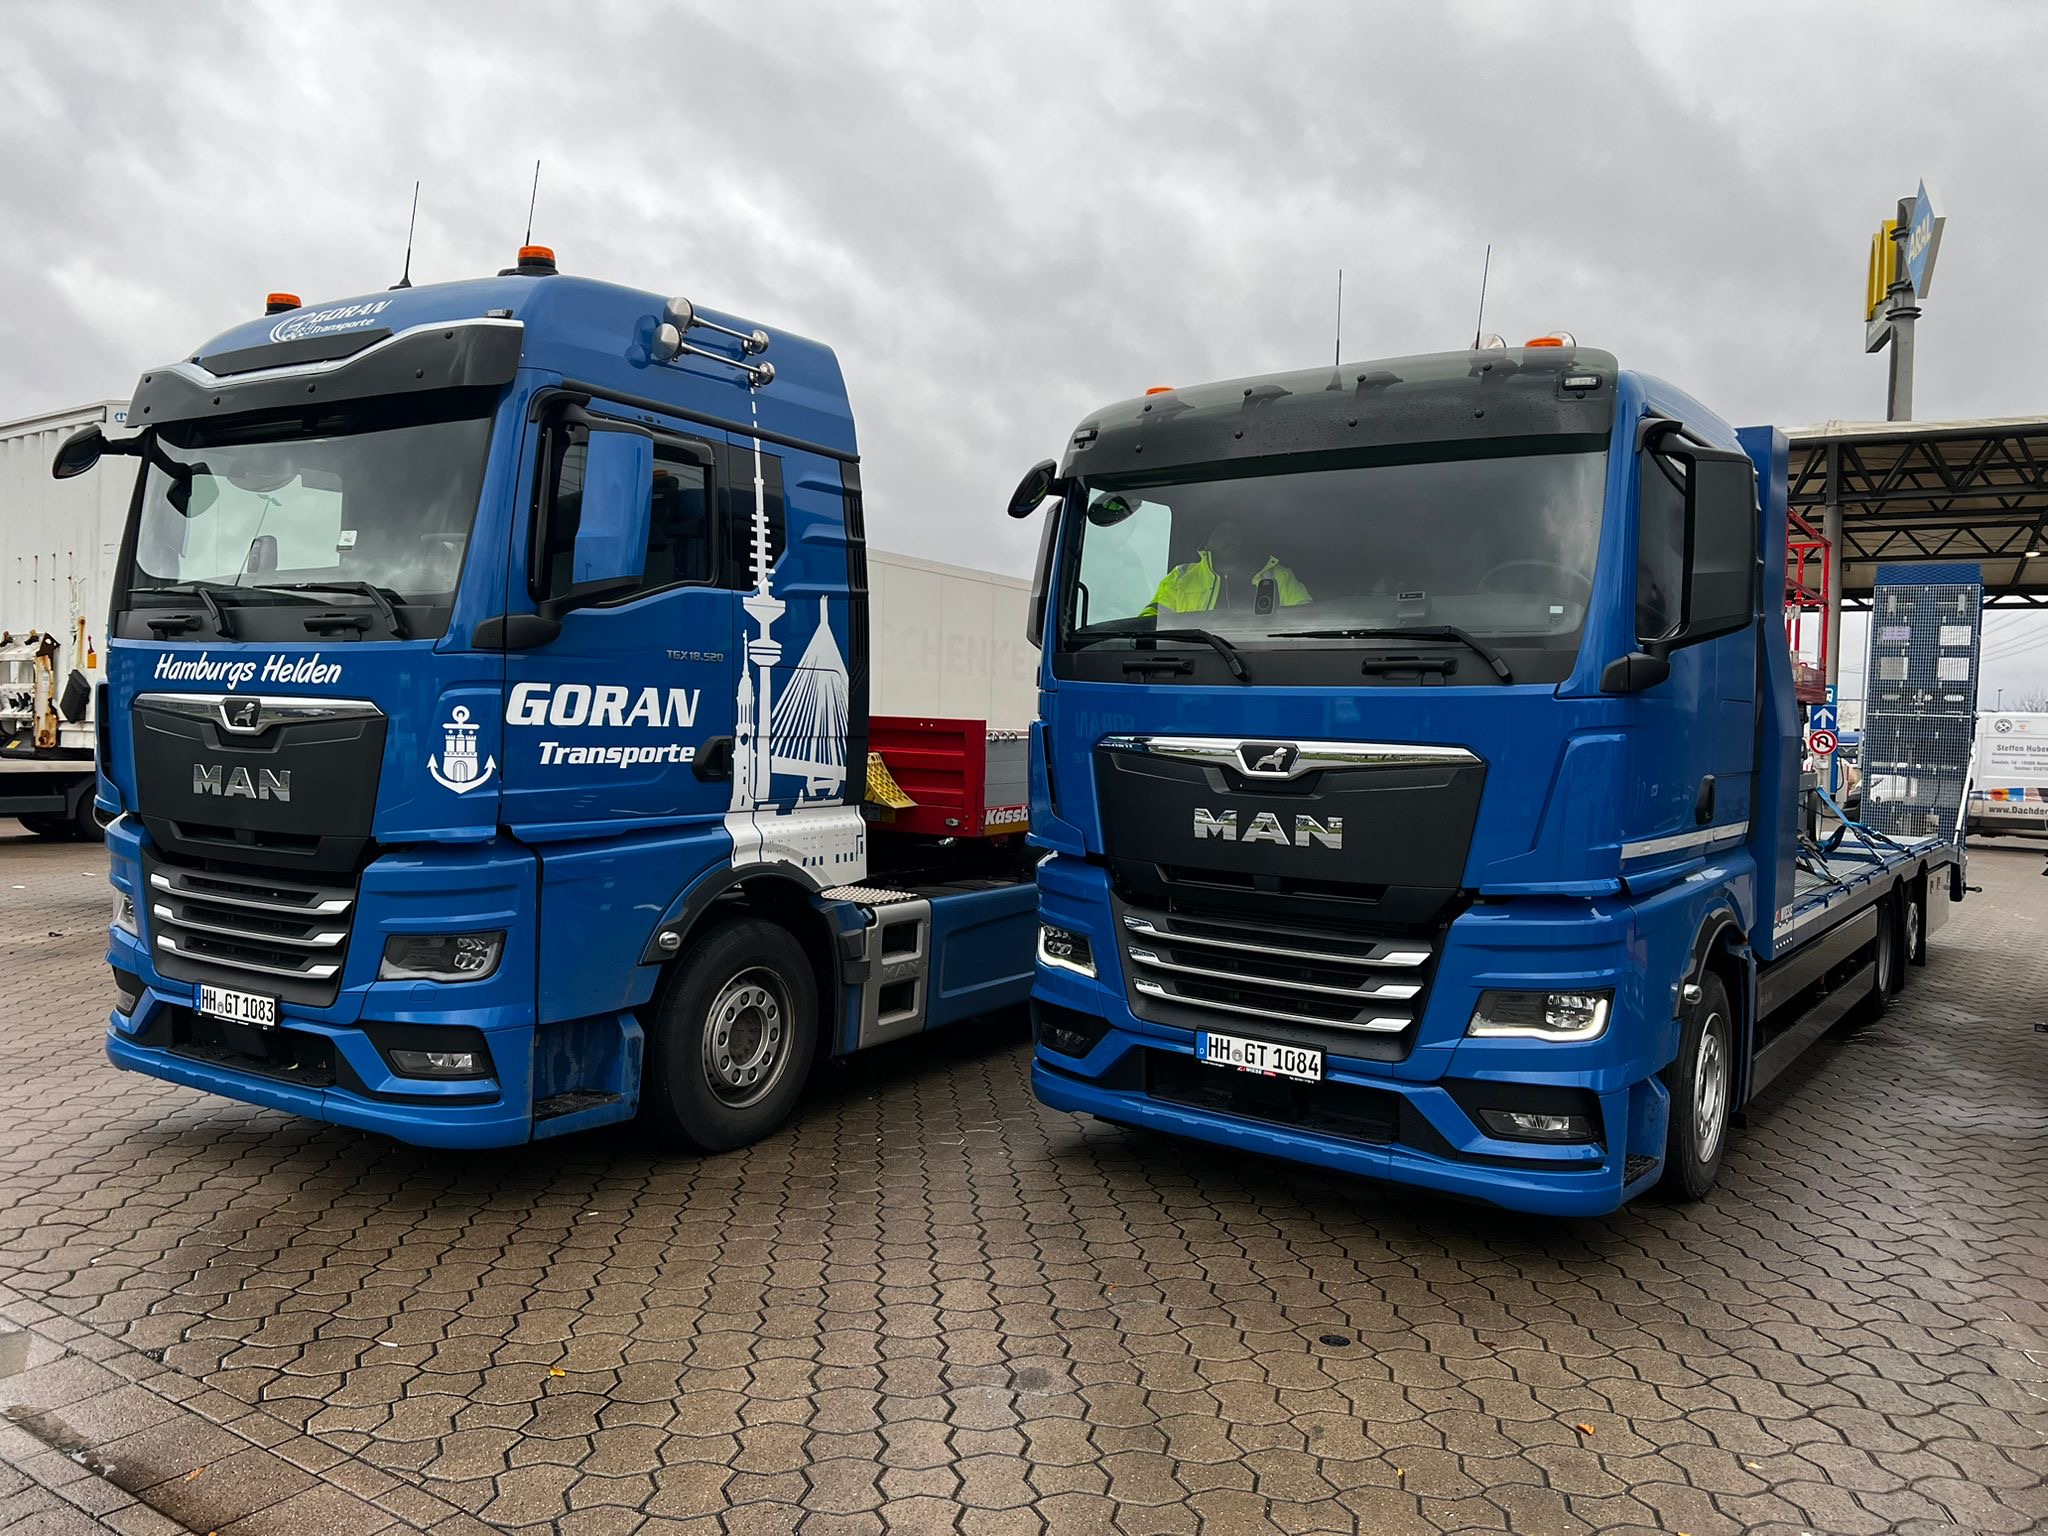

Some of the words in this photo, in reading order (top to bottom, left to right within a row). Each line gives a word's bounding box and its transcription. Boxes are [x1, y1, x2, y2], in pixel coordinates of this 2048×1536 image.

[1908, 213, 1932, 265] ARAL
[311, 318, 375, 334] Transporte
[317, 299, 393, 321] GORAN
[154, 651, 257, 691] Hamburgs
[260, 652, 342, 684] Helden
[666, 650, 688, 660] TGX
[689, 651, 724, 662] 18.520
[506, 682, 701, 727] GORAN
[538, 741, 696, 769] Transporte
[1996, 744, 2025, 752] Steffen
[193, 763, 291, 802] MAN
[1193, 807, 1344, 850] MAN
[202, 988, 217, 1011] HH
[225, 993, 240, 1016] GT
[243, 996, 274, 1022] 1083
[1208, 1036, 1231, 1060] HH
[1244, 1043, 1267, 1067] GT
[1273, 1048, 1319, 1076] 1084
